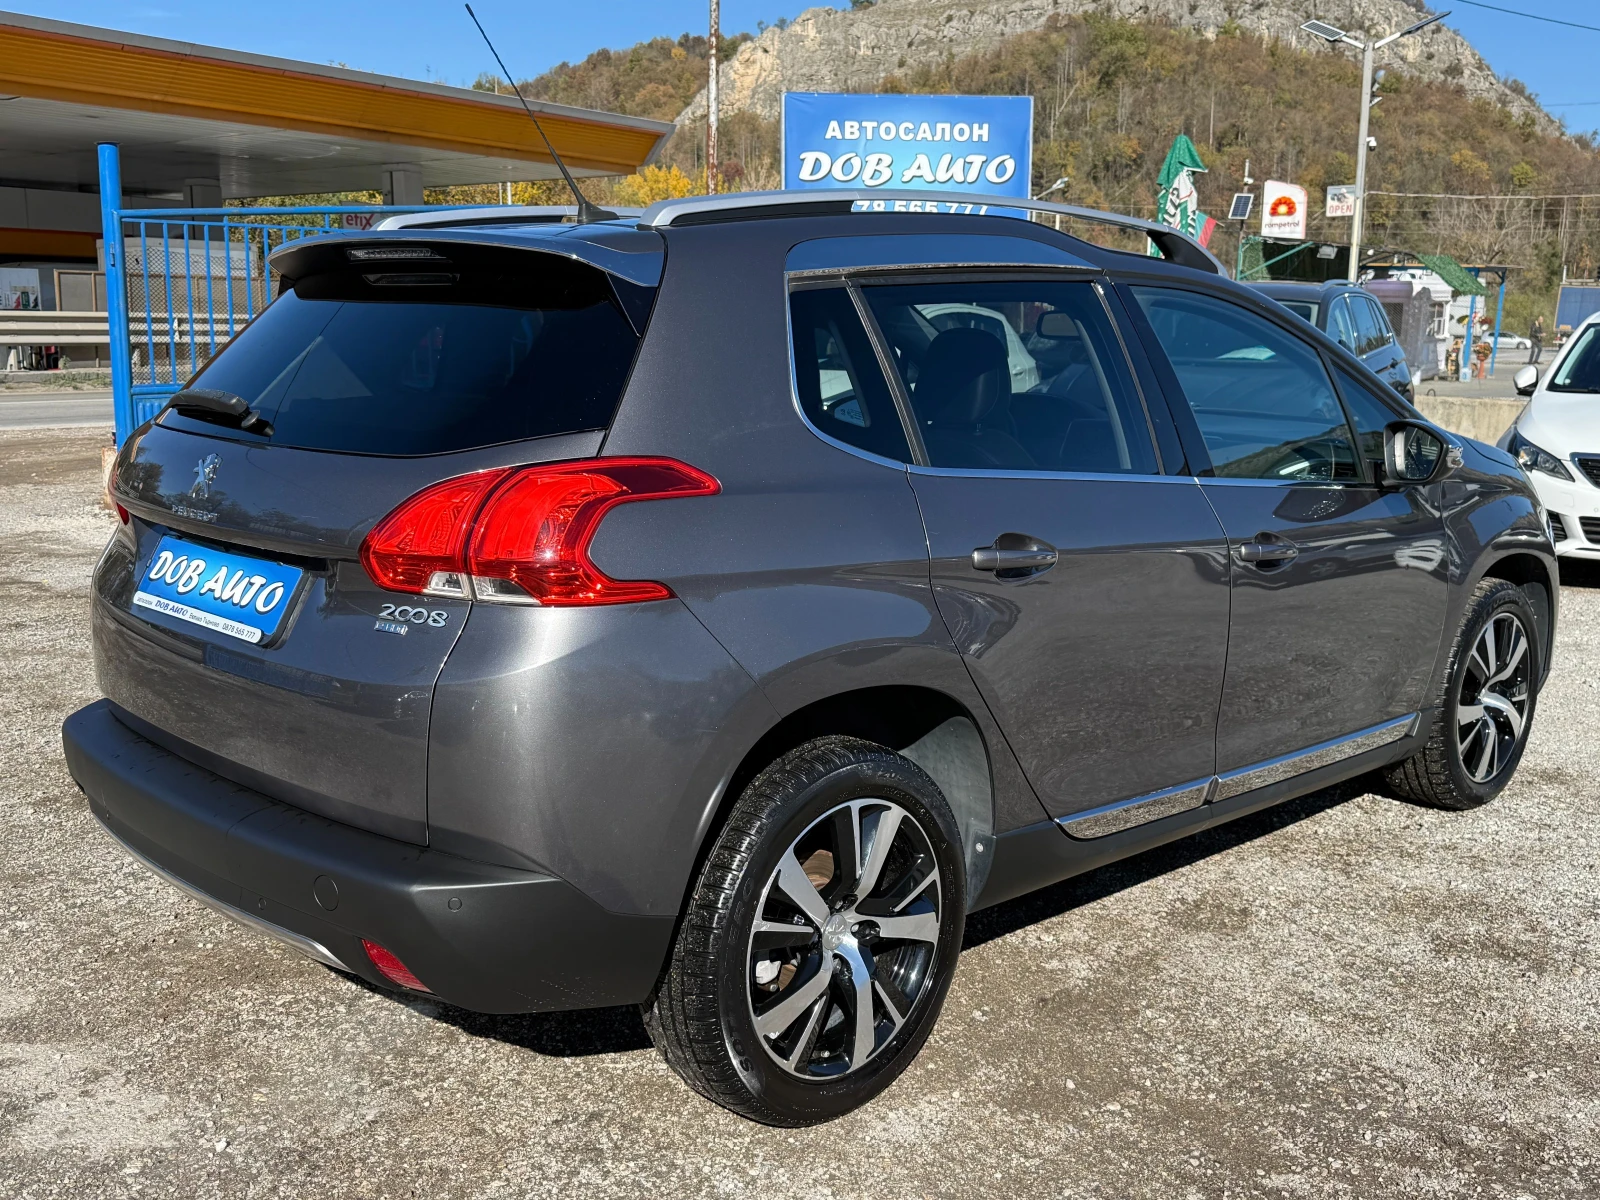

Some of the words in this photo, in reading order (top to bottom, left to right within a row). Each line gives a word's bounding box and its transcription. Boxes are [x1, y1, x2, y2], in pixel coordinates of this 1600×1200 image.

[824, 120, 989, 142] АВТОСАЛОН
[798, 151, 893, 187] DOB
[901, 153, 1017, 185] AUTO
[850, 200, 885, 211] 78
[945, 203, 989, 215] 777
[1328, 204, 1352, 215] OPEN
[1264, 220, 1300, 230] rompetrol
[172, 504, 218, 523] PEUGEOT
[149, 550, 206, 595] DOB
[199, 565, 285, 615] AUTO
[155, 600, 170, 611] DOB
[169, 604, 189, 616] AUTO
[221, 622, 236, 633] 0878
[234, 626, 245, 636] 565
[244, 630, 256, 639] 777
[378, 603, 450, 628] 2008
